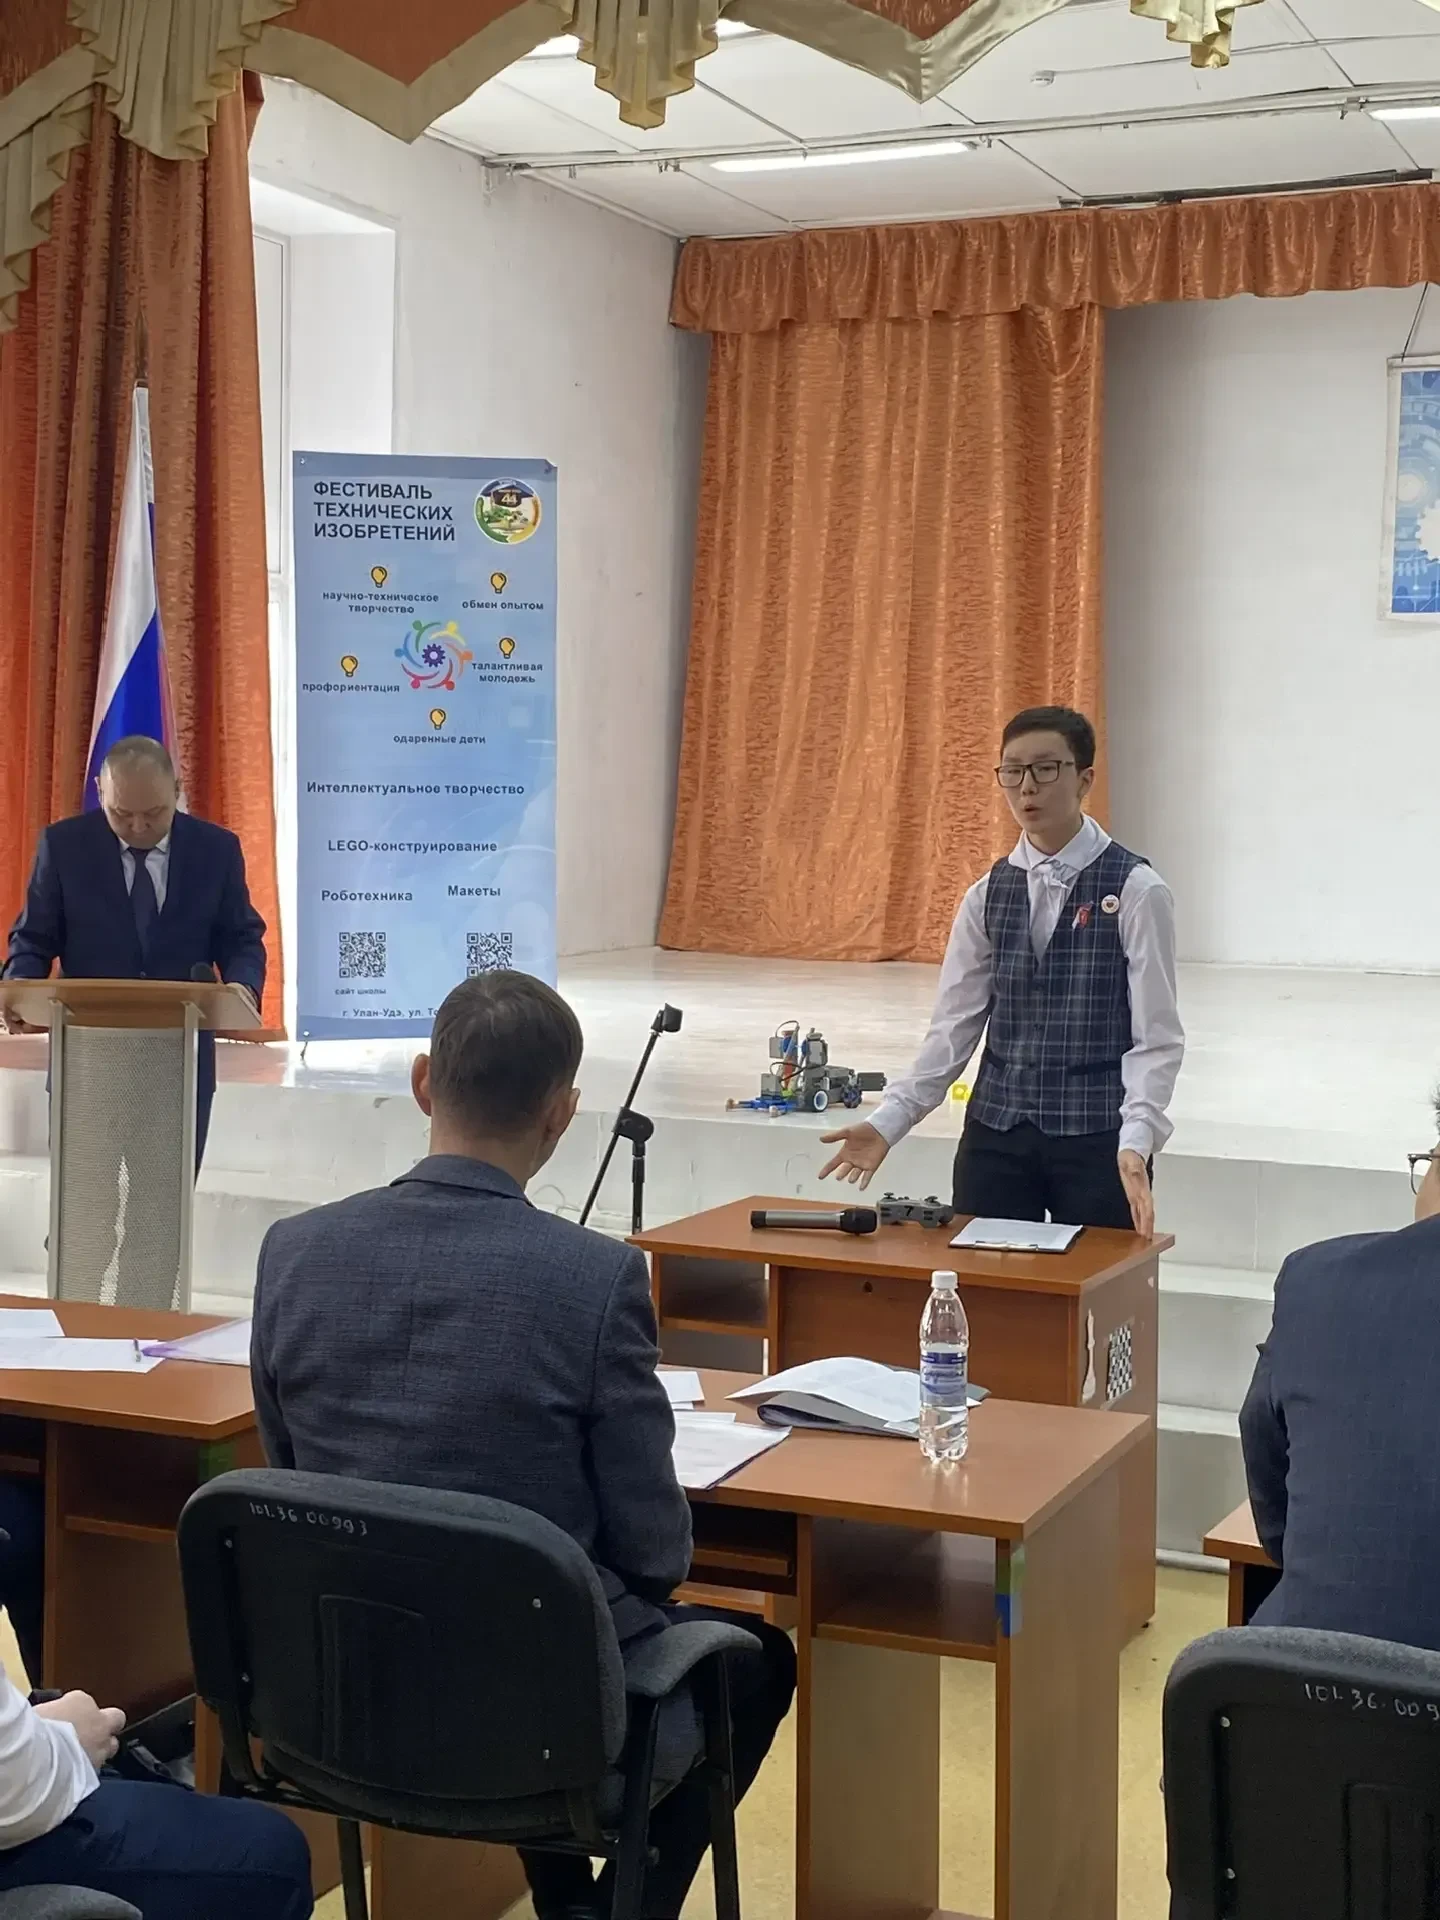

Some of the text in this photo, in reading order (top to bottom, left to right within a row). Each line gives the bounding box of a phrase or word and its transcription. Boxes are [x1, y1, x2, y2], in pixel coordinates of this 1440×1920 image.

[313, 481, 433, 500] ФЕСТИВАЛЬ
[313, 501, 454, 521] ТЕХНИЧЕСКИХ
[313, 523, 456, 542] ИЗОБРЕТЕНИЙ
[322, 591, 439, 603] научно-техническое
[348, 604, 415, 614] творчество
[462, 599, 544, 612] обмен опытом
[471, 662, 543, 672] талантливая
[478, 674, 536, 685] молодежь
[302, 682, 400, 694] профориентация
[393, 734, 486, 745] одаренные дети
[307, 781, 525, 797] Интеллектуальное творчество
[328, 840, 498, 854] LEGO-конструирование
[321, 890, 413, 902] Роботехника
[448, 885, 501, 897] Макеты
